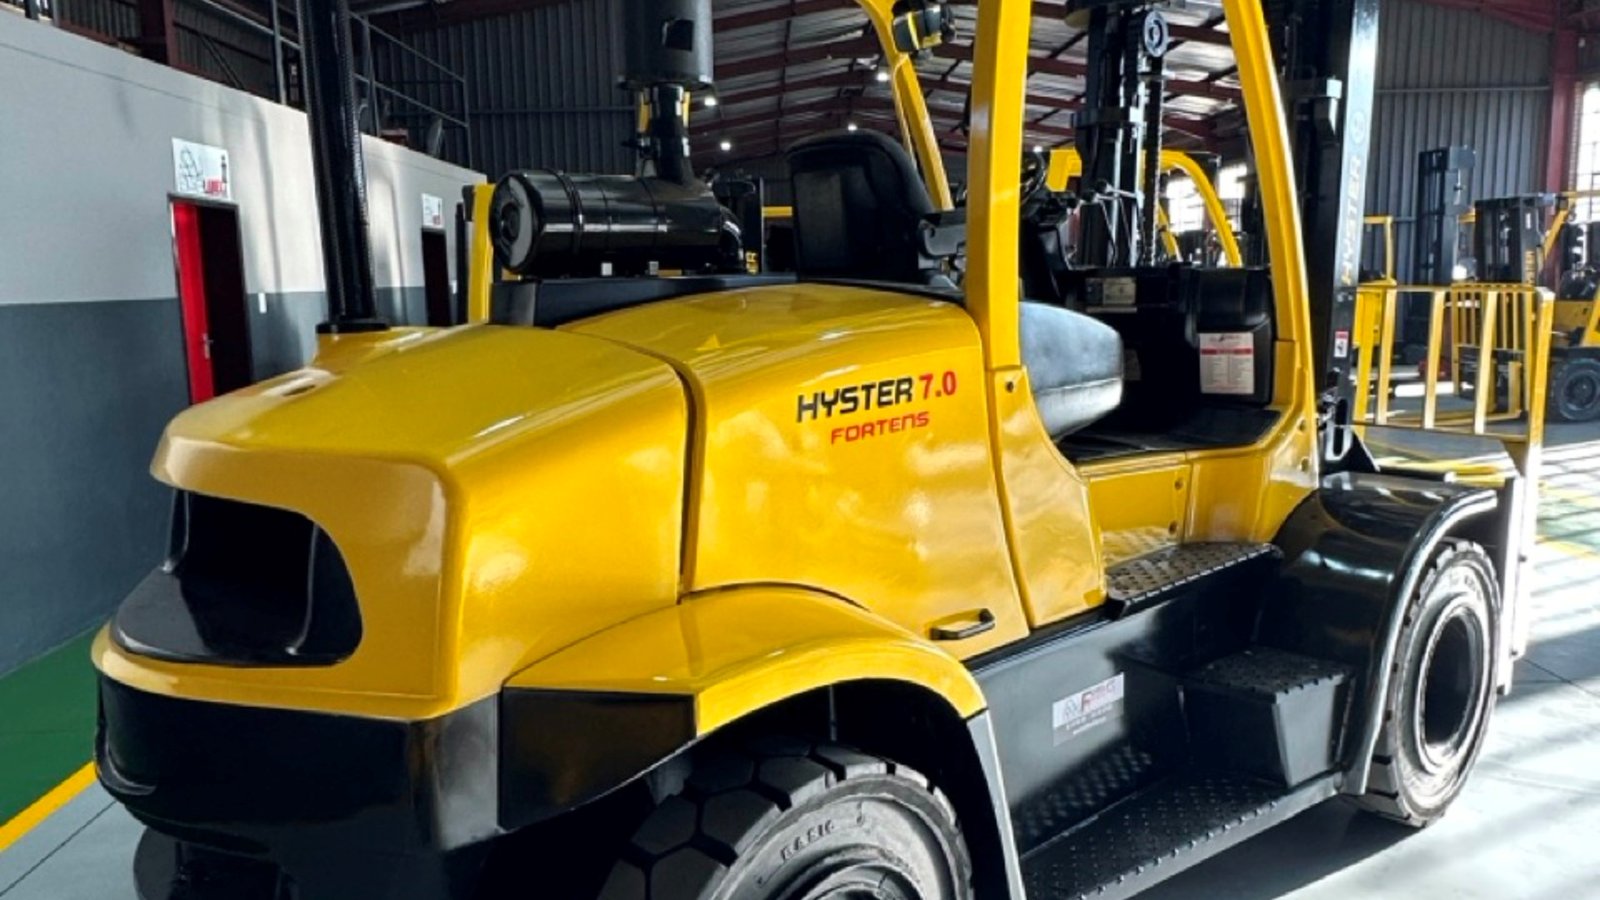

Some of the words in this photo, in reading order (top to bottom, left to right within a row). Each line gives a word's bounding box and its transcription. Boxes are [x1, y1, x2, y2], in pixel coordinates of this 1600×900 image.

[797, 377, 913, 423] HYSTER
[919, 370, 957, 400] 7.0
[831, 411, 929, 445] FORTENS
